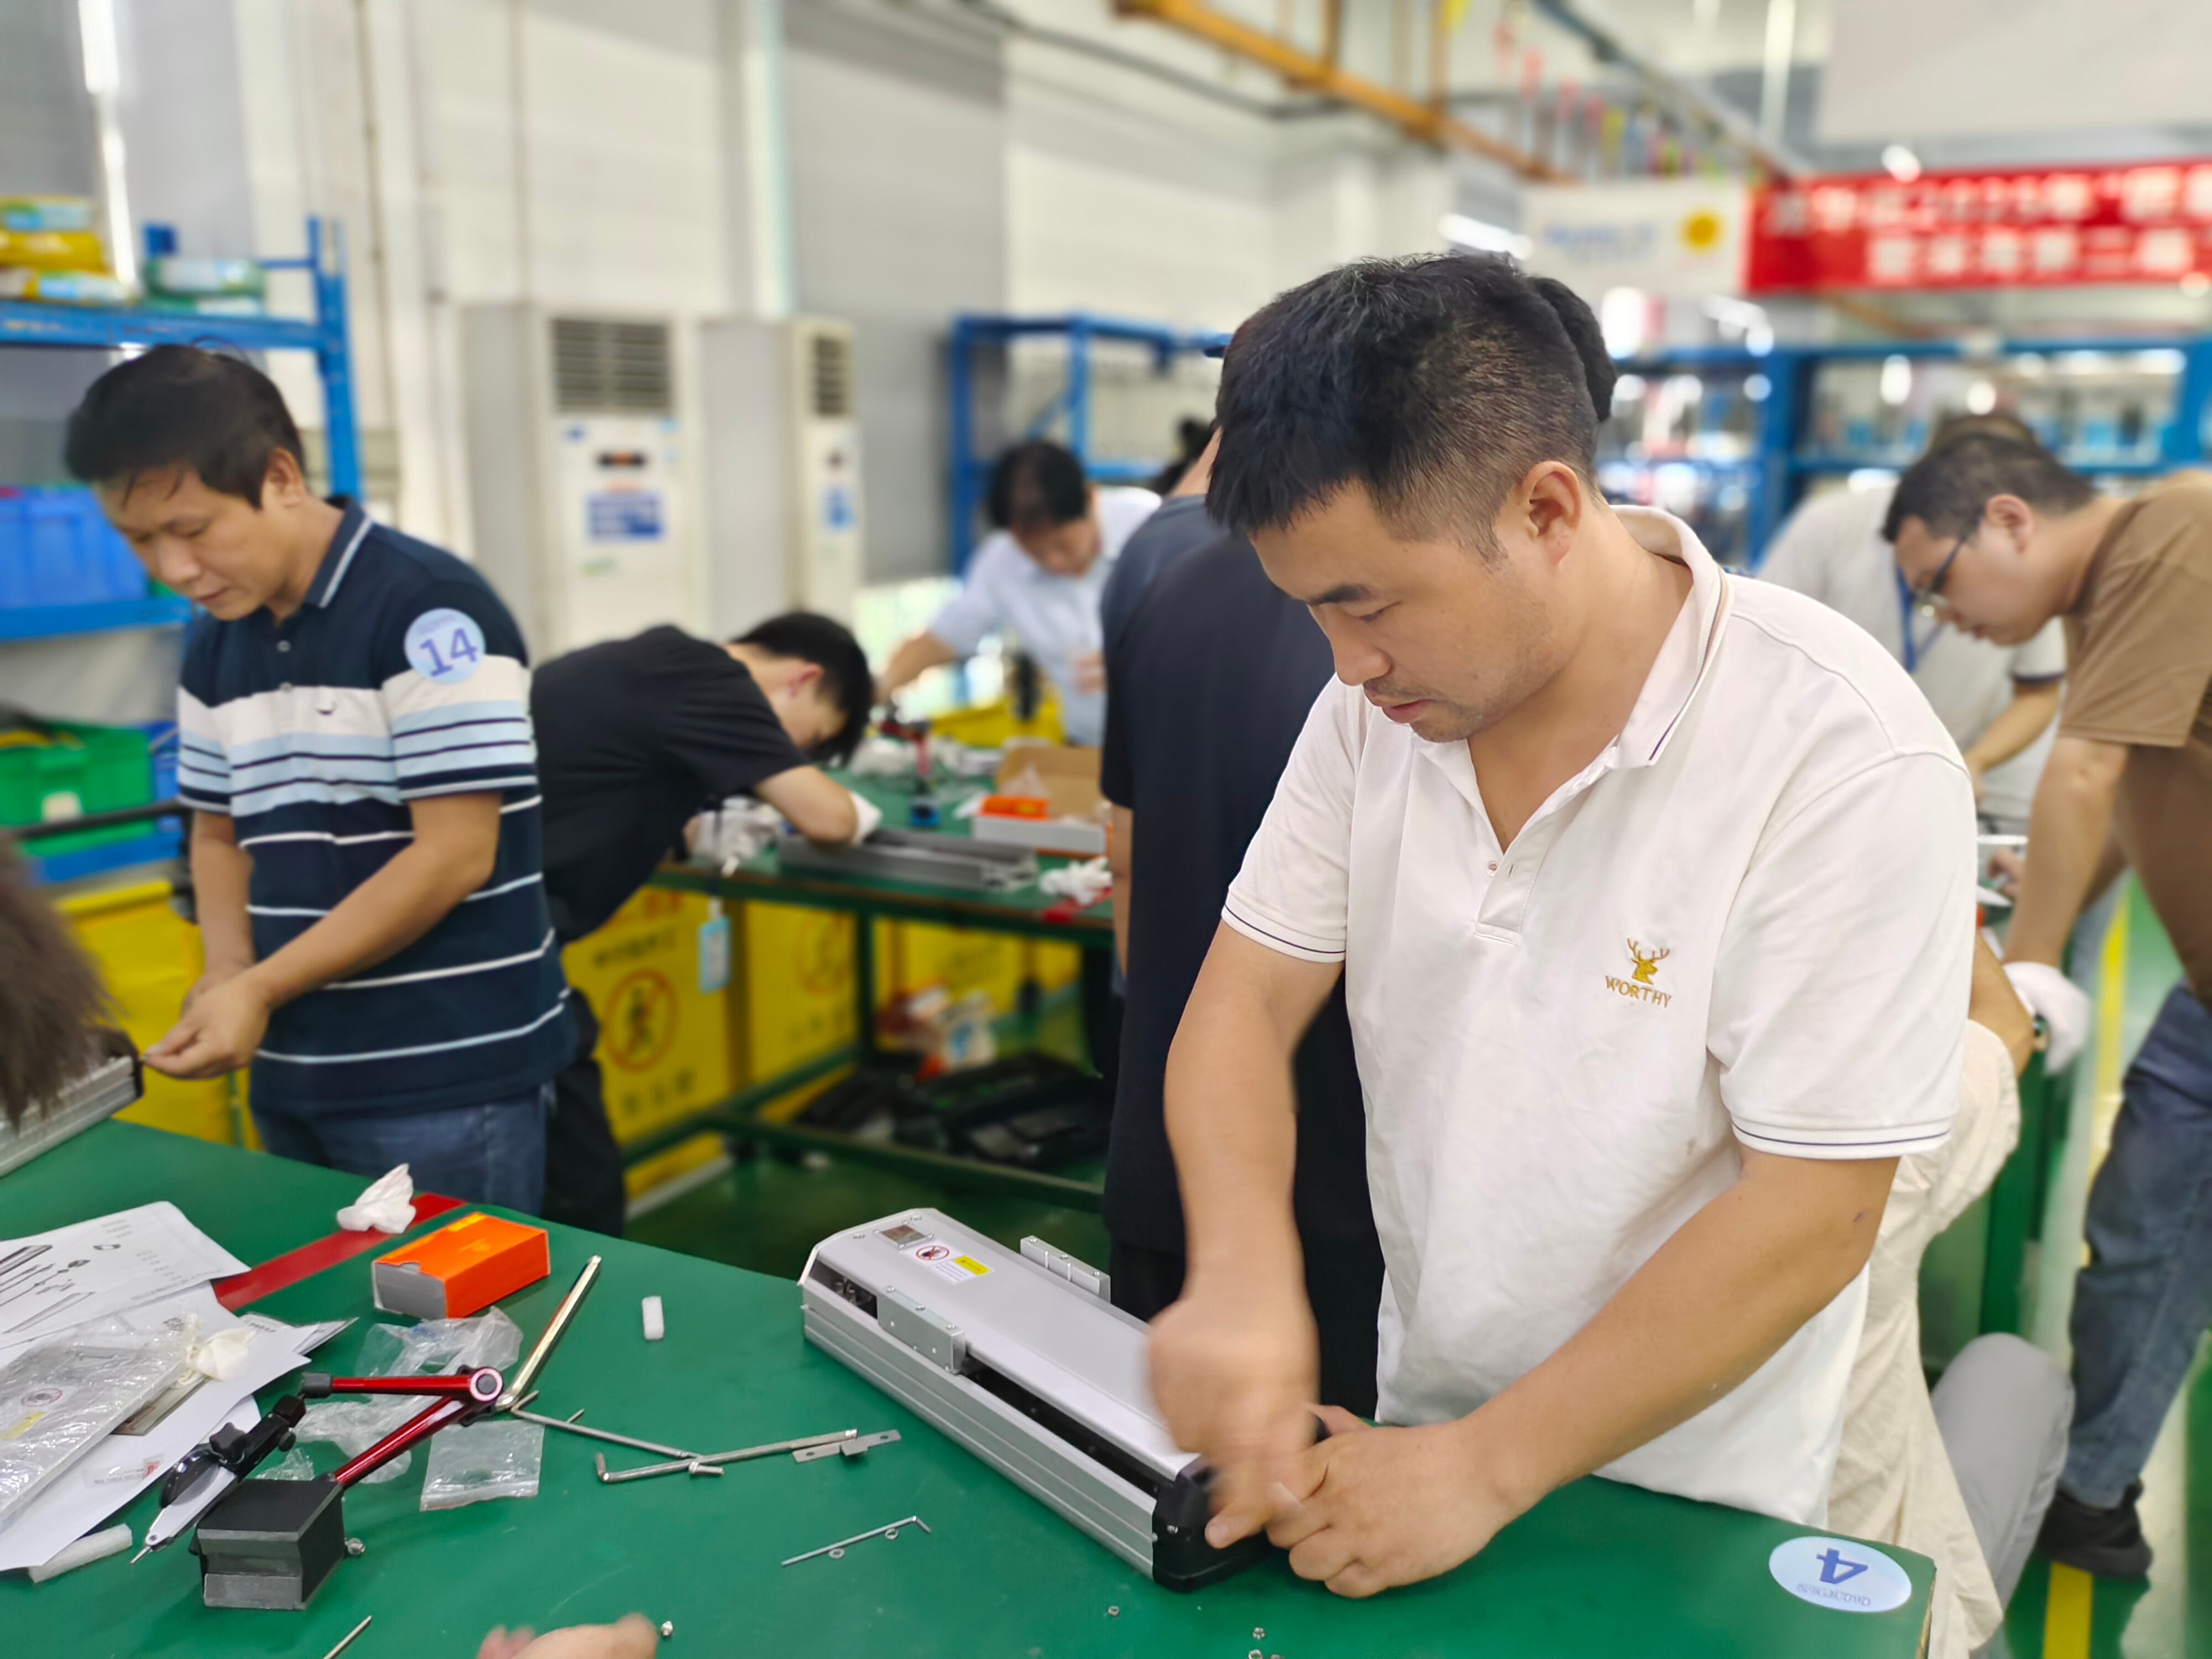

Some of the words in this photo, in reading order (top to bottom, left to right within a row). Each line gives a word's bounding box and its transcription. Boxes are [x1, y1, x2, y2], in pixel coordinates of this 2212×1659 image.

[419, 628, 477, 677] 14
[1605, 975, 1672, 1008] WORTHY
[1816, 1547, 1869, 1584] 4
